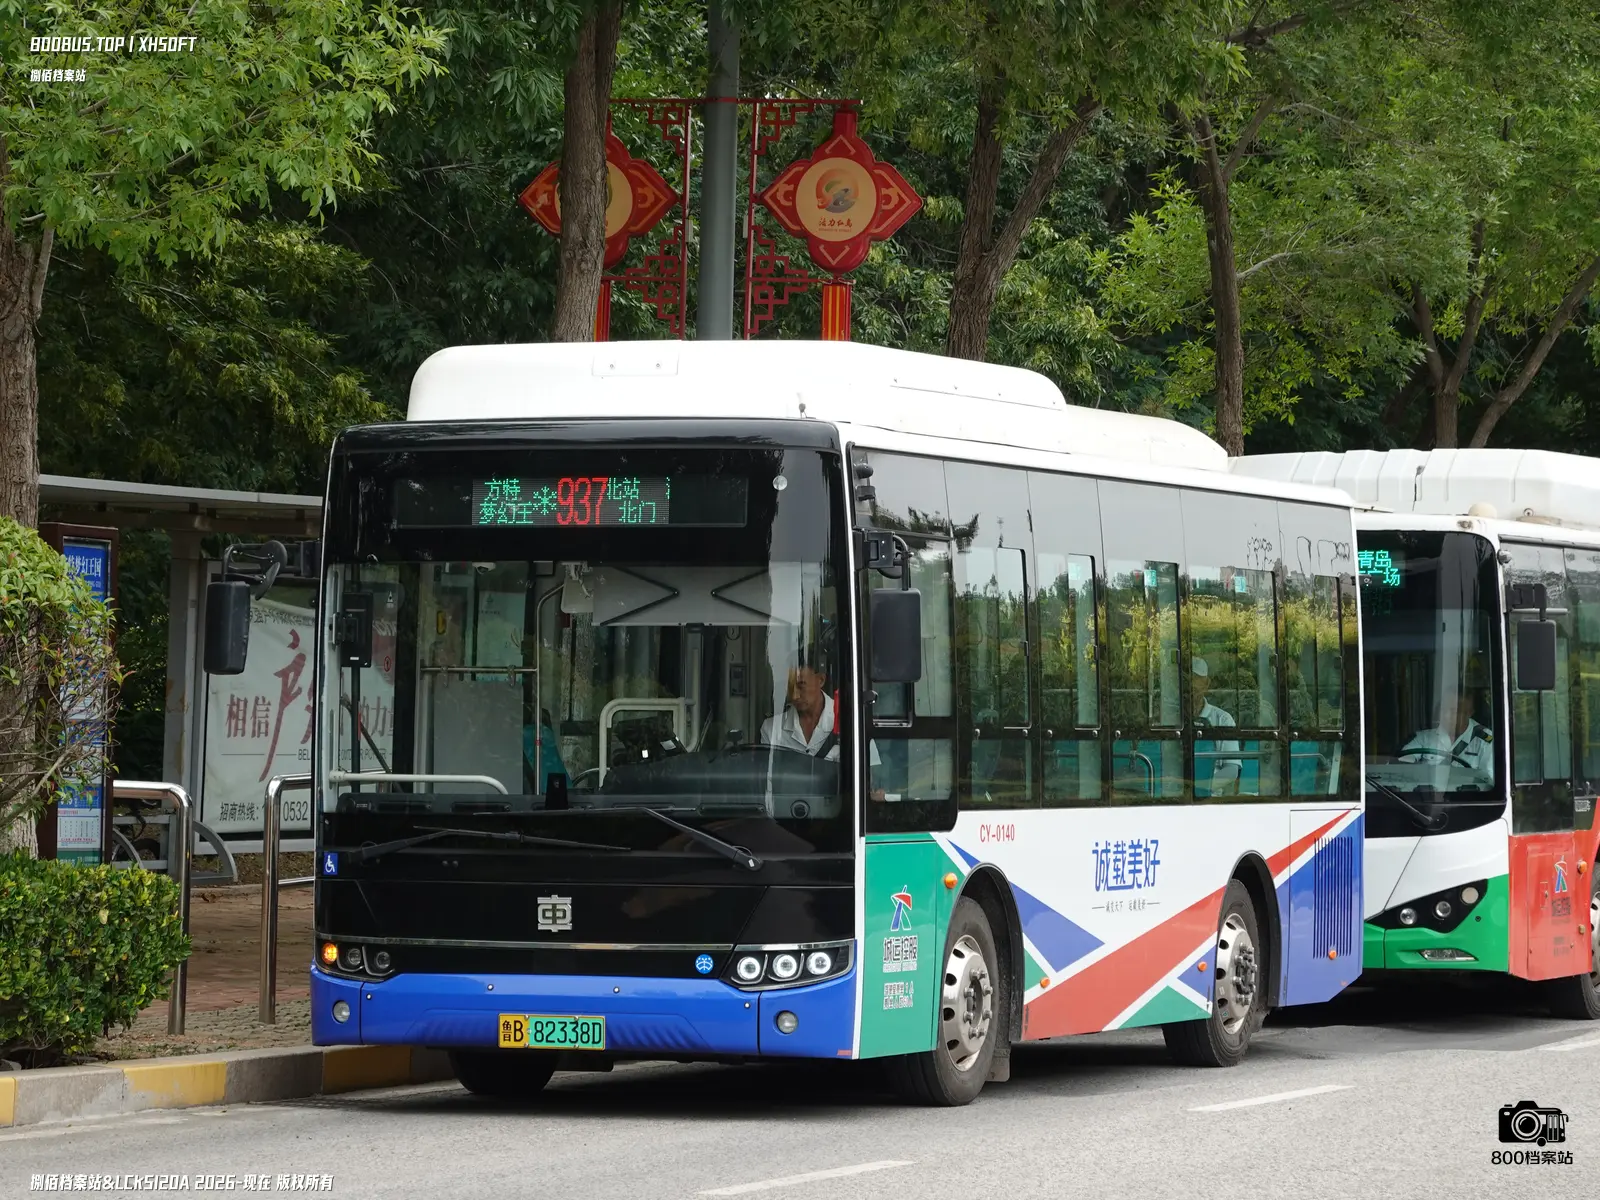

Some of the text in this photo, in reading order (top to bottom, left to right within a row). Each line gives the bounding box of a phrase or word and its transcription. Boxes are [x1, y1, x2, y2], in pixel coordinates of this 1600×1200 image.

[484, 478, 521, 501] 方特
[556, 477, 609, 525] 937
[479, 501, 534, 524] 梦幻王
[618, 500, 656, 523] 北门
[66, 555, 102, 577] 特梦幻王国
[1357, 550, 1392, 569] 青岛
[282, 800, 309, 822] 0532
[979, 823, 1015, 843] CY-0140
[1091, 838, 1161, 892] 诚载美好
[883, 935, 918, 962] 城运控股
[502, 1020, 602, 1045] 鲁B 82338D
